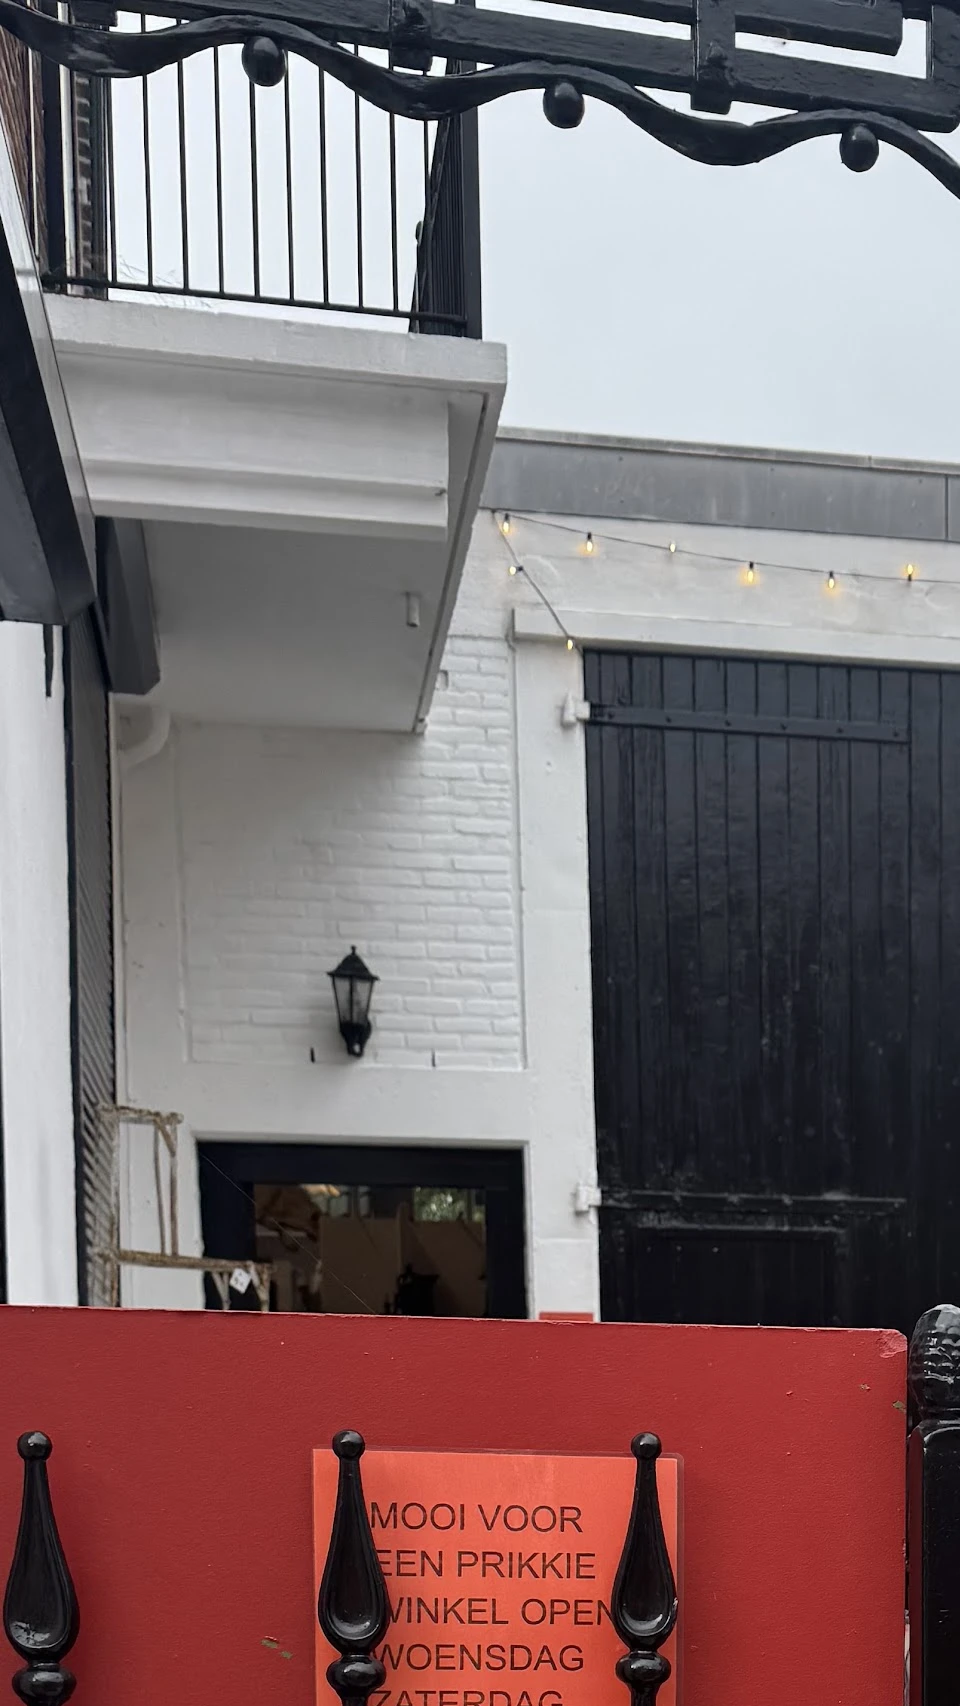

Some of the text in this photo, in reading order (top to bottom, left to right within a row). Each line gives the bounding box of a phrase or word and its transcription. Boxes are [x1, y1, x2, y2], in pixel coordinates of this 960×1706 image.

[370, 1501, 583, 1533] MOOI VOOR
[457, 1550, 596, 1580] PRIKKIE
[373, 1643, 584, 1672] WOENSDAG
